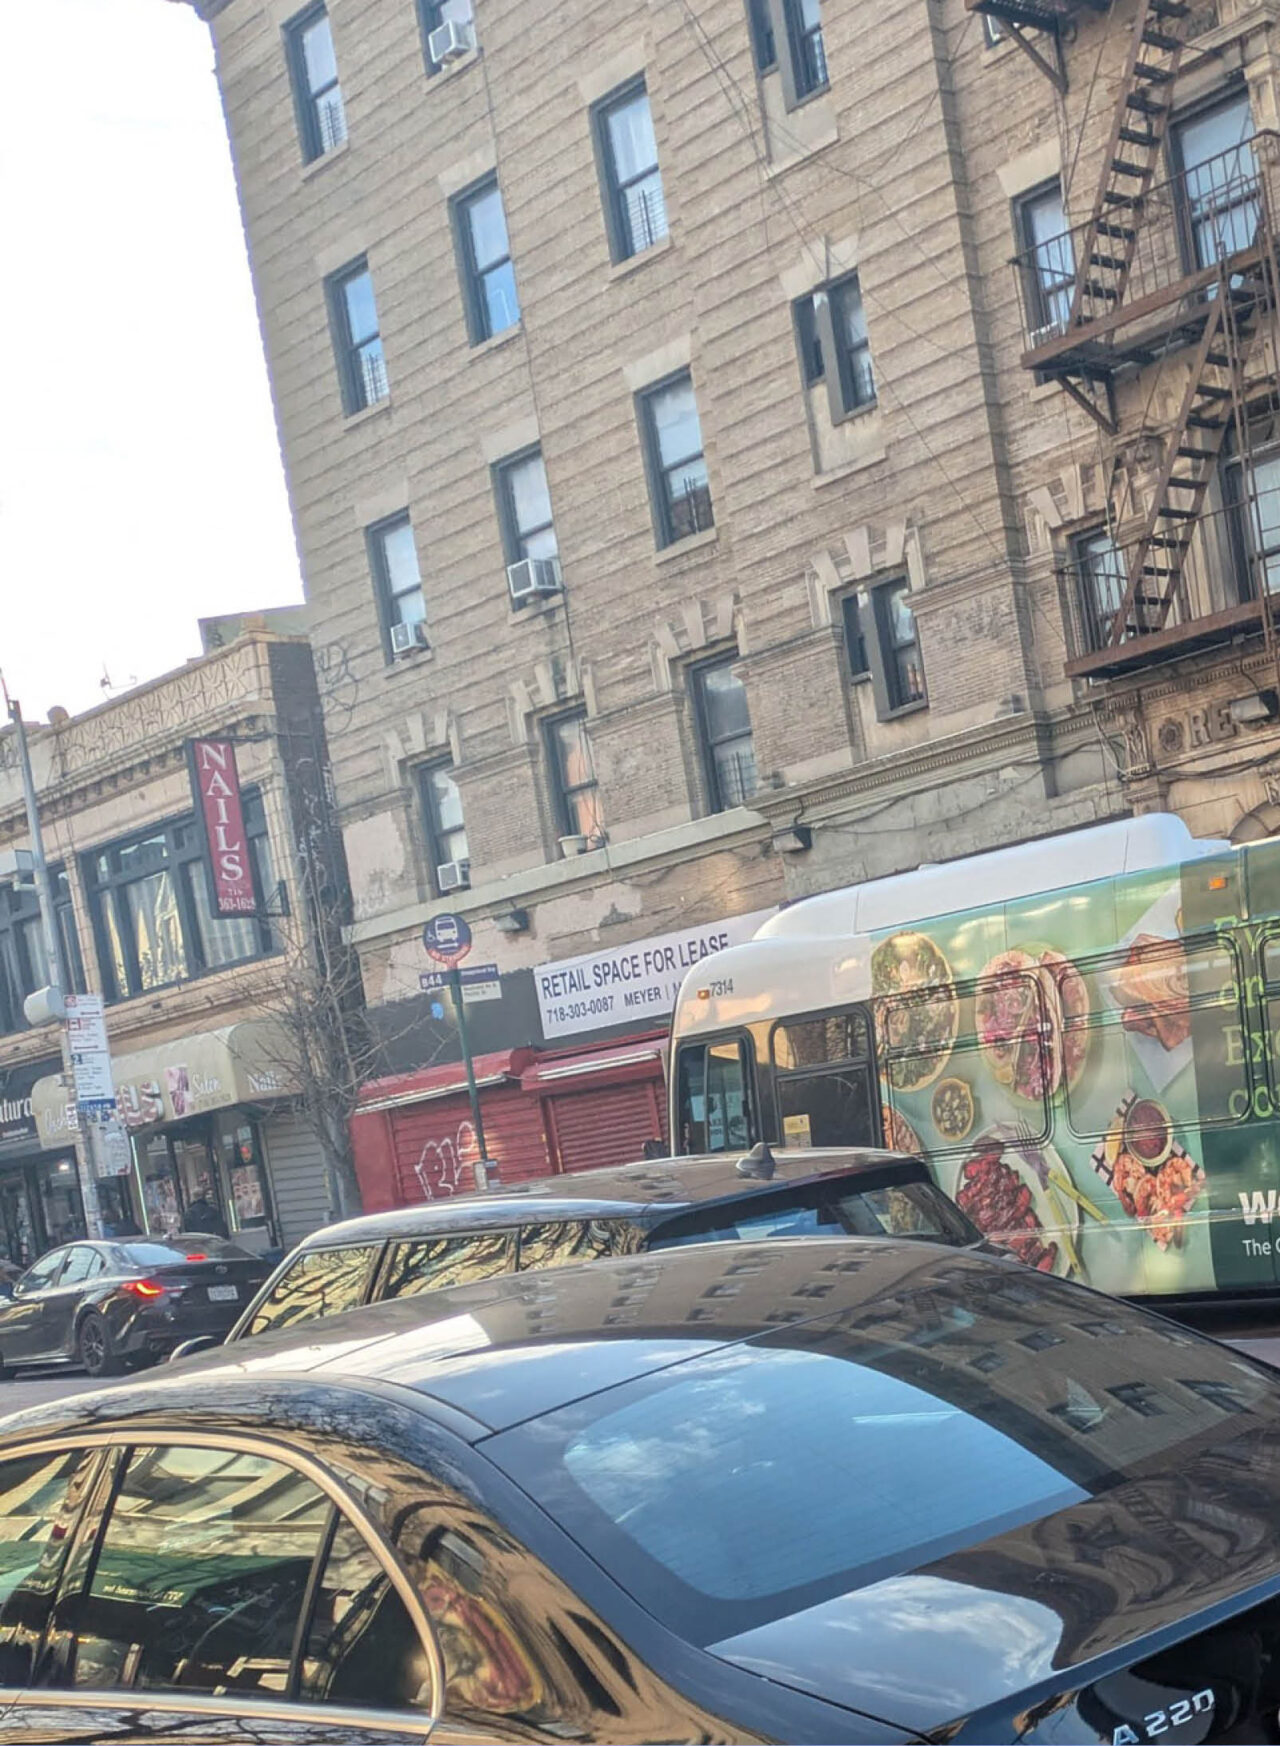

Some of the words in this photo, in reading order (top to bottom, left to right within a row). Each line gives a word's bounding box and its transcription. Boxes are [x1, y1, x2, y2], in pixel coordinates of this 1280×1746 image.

[202, 744, 243, 881] NAILS
[541, 967, 591, 999] RETAIL
[592, 955, 642, 988] SPACE
[644, 947, 676, 975] FOR
[710, 978, 734, 997] 7314
[547, 996, 614, 1024] 718-303-0087
[624, 987, 662, 1007] MEYER
[1242, 1239, 1271, 1257] The
[1113, 1724, 1139, 1745] A
[1144, 1689, 1215, 1737] 220
